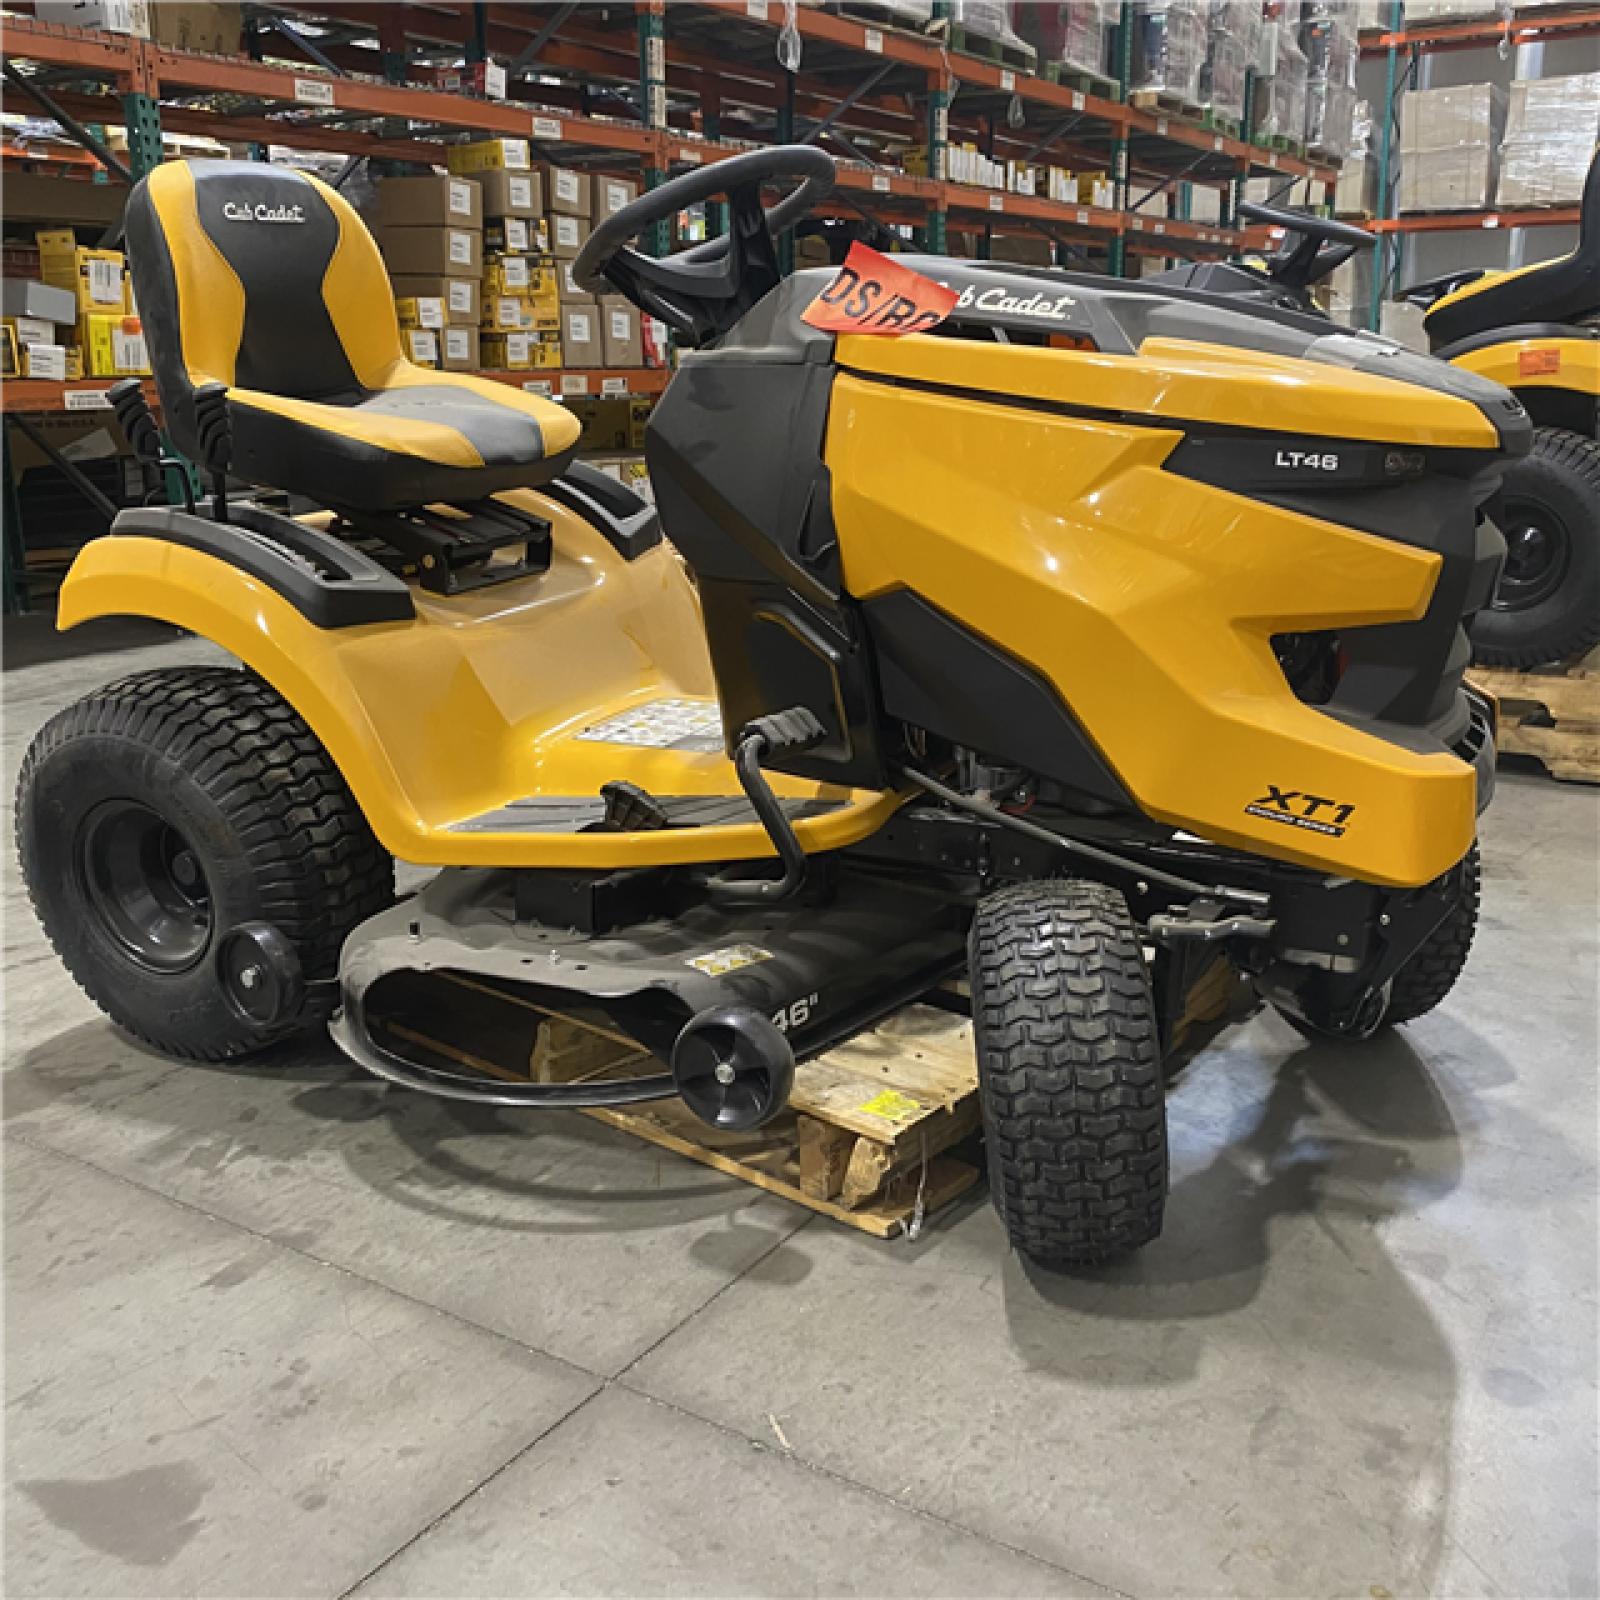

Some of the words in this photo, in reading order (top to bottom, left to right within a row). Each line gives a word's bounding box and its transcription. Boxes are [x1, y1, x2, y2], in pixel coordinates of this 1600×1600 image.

[223, 201, 254, 221] Cub
[254, 203, 306, 223] Cadet
[975, 286, 1077, 319] Cadet
[1275, 451, 1338, 471] LT46
[1253, 784, 1356, 824] XT1
